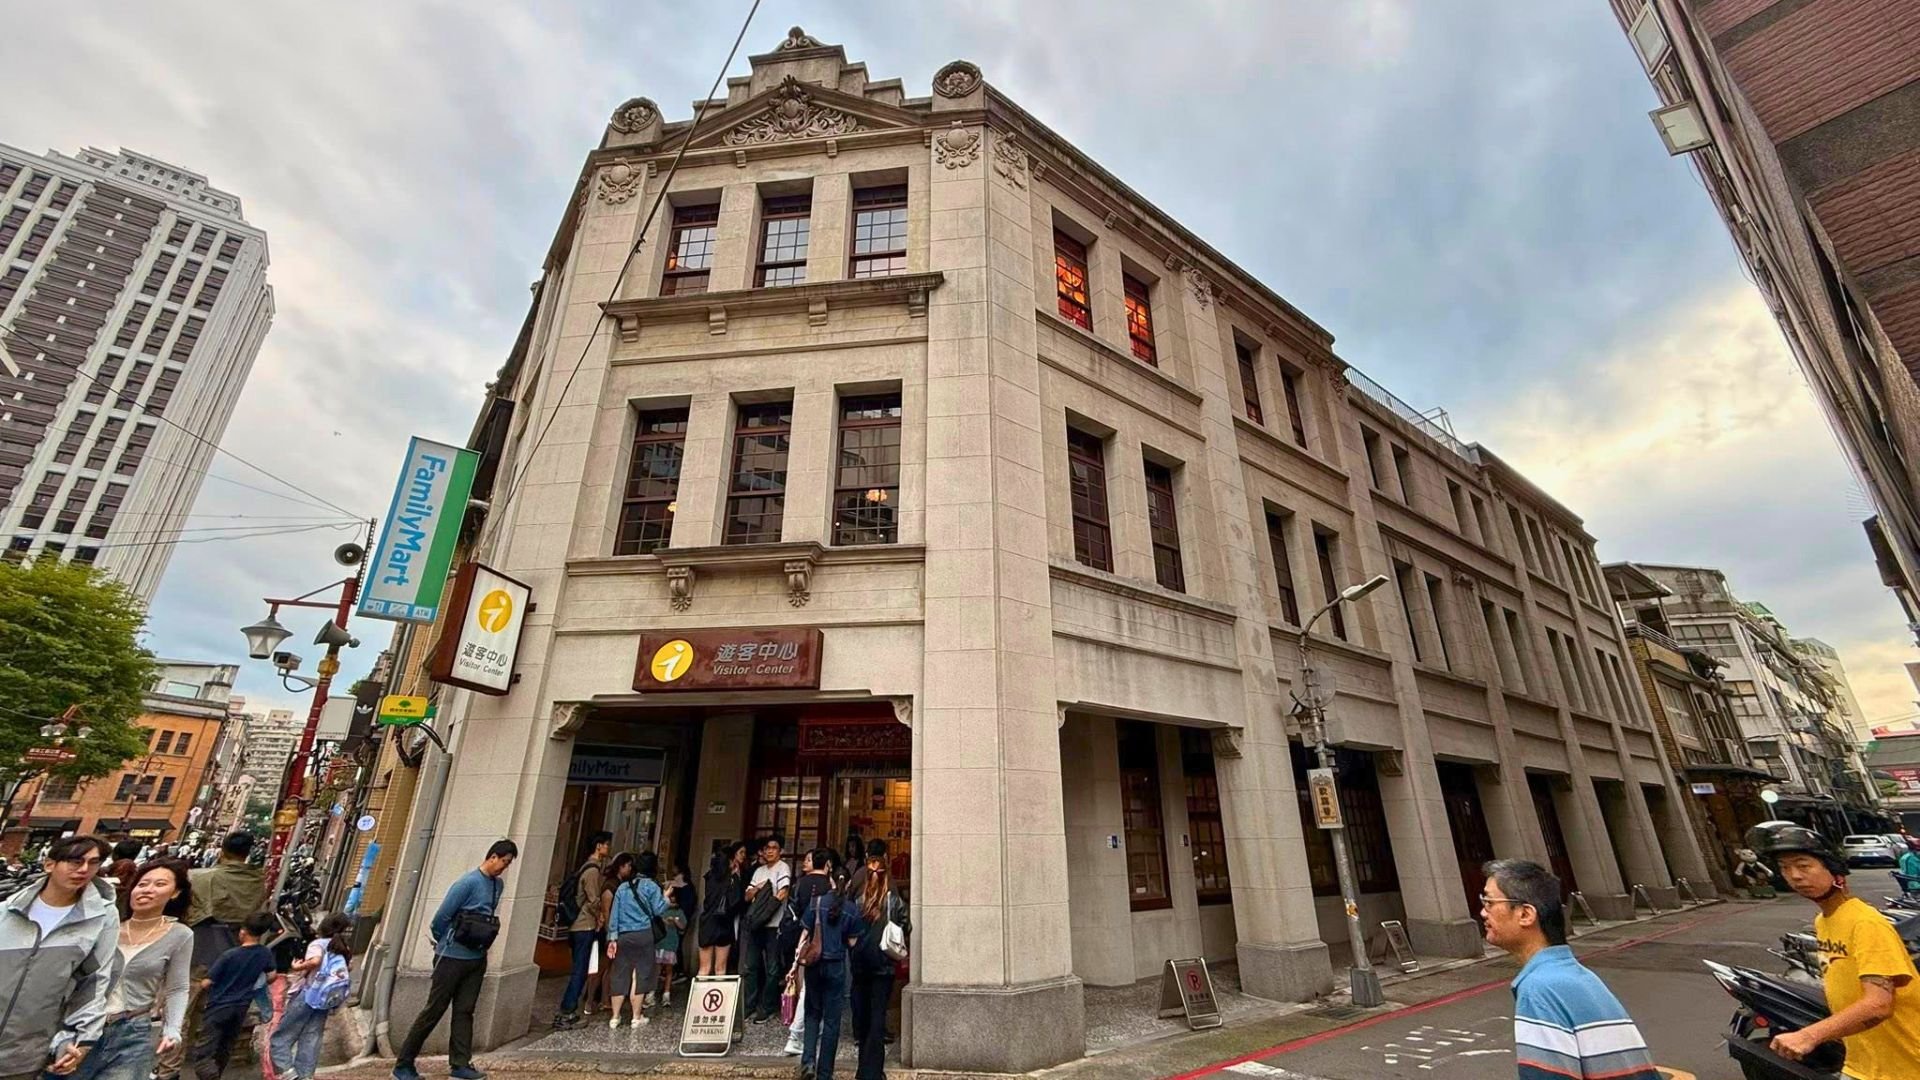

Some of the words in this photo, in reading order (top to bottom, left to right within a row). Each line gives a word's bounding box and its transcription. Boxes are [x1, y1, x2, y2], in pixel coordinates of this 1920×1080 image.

[383, 454, 447, 586] FamilyMart
[462, 642, 508, 667] 遊客中心
[714, 641, 799, 662] 遊客中心
[459, 657, 481, 671] Visitor
[483, 664, 504, 677] Center
[713, 664, 751, 675] Visitor
[756, 663, 794, 675] Center
